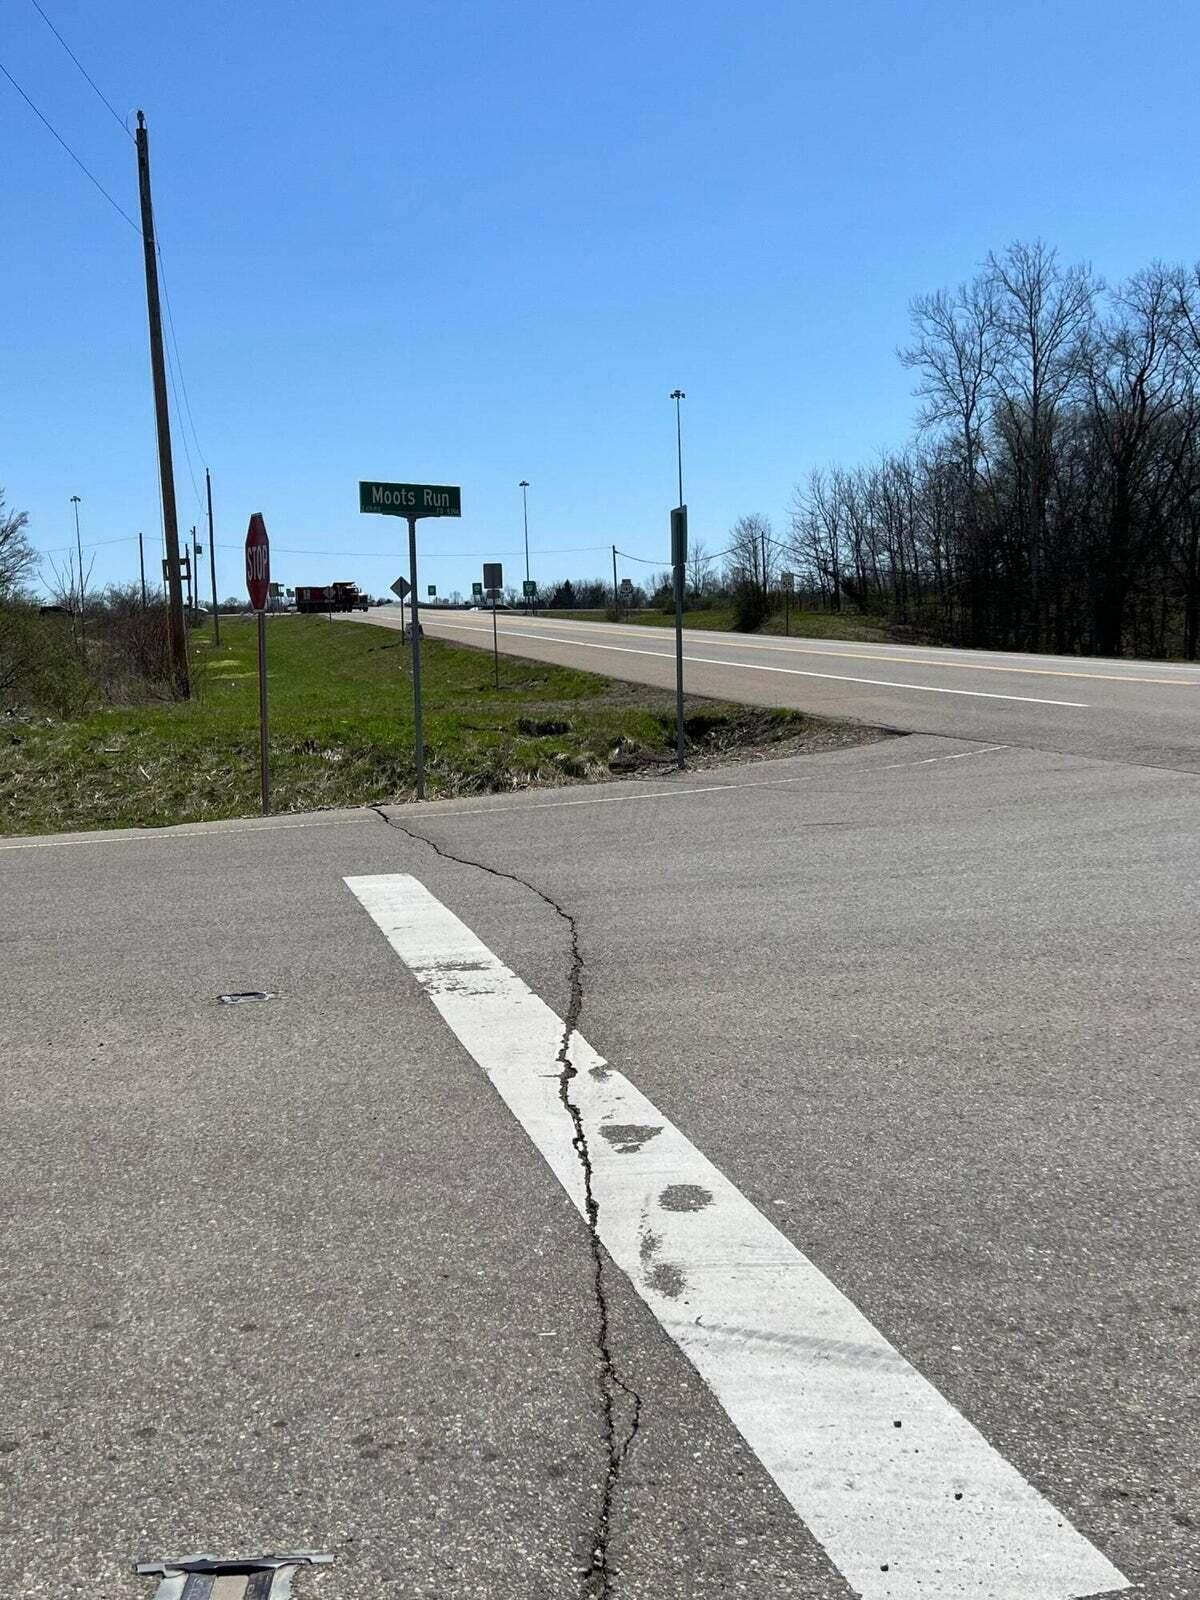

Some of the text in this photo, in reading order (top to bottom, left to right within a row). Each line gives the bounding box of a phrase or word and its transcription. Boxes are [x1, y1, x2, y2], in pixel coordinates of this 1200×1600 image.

[372, 486, 450, 507] Moots Run
[247, 545, 268, 581] STOP
